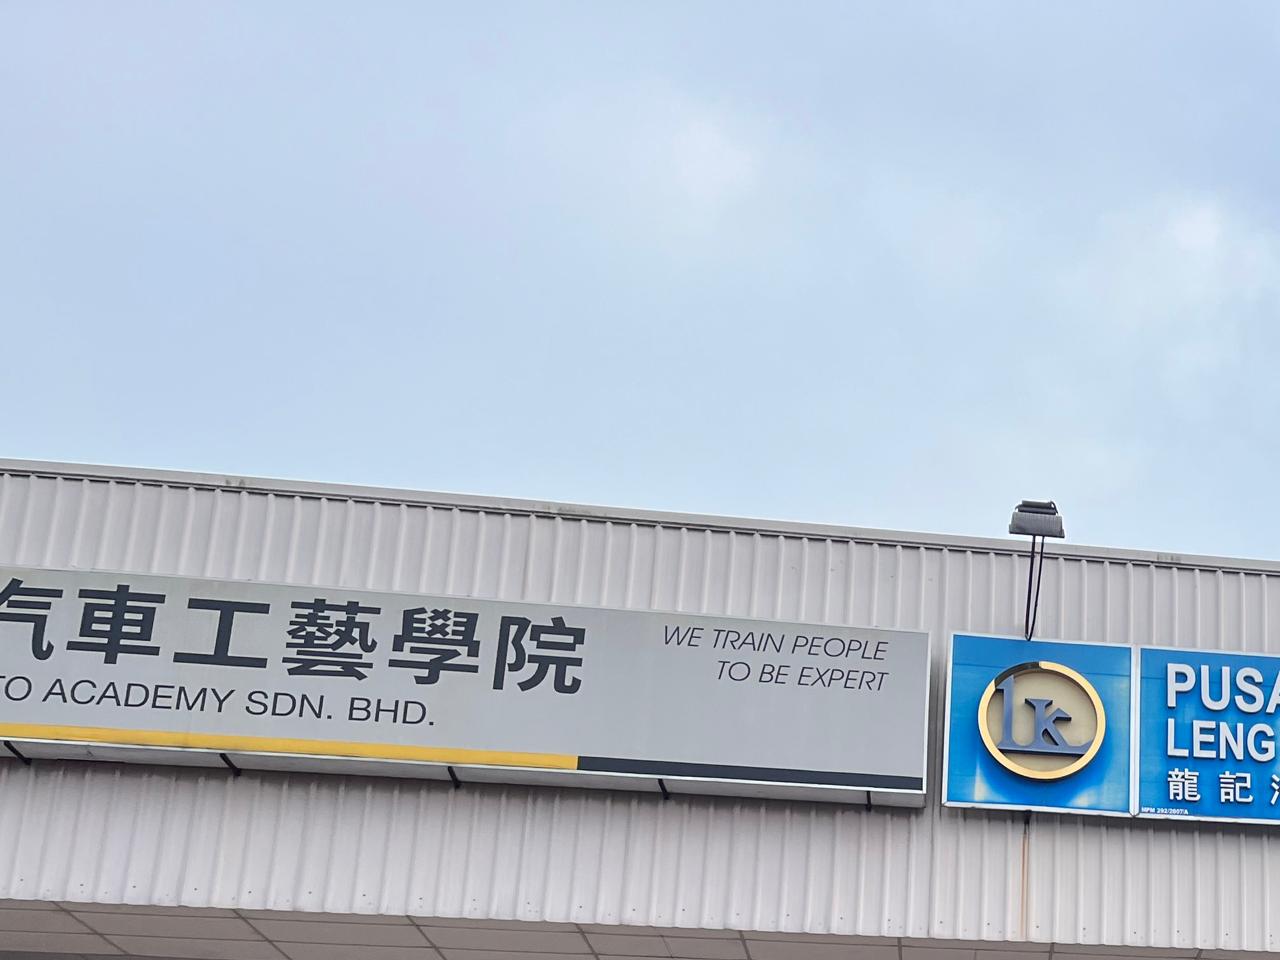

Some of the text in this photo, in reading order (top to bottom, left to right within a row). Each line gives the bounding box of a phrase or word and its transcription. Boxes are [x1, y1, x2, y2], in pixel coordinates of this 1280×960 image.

[664, 625, 889, 661] WE TRAIN PEOPLE
[717, 660, 889, 691] TO BE EXPERT
[0, 675, 435, 726] O ACADEMY SDN. BHD.
[1167, 718, 1275, 763] LENG
